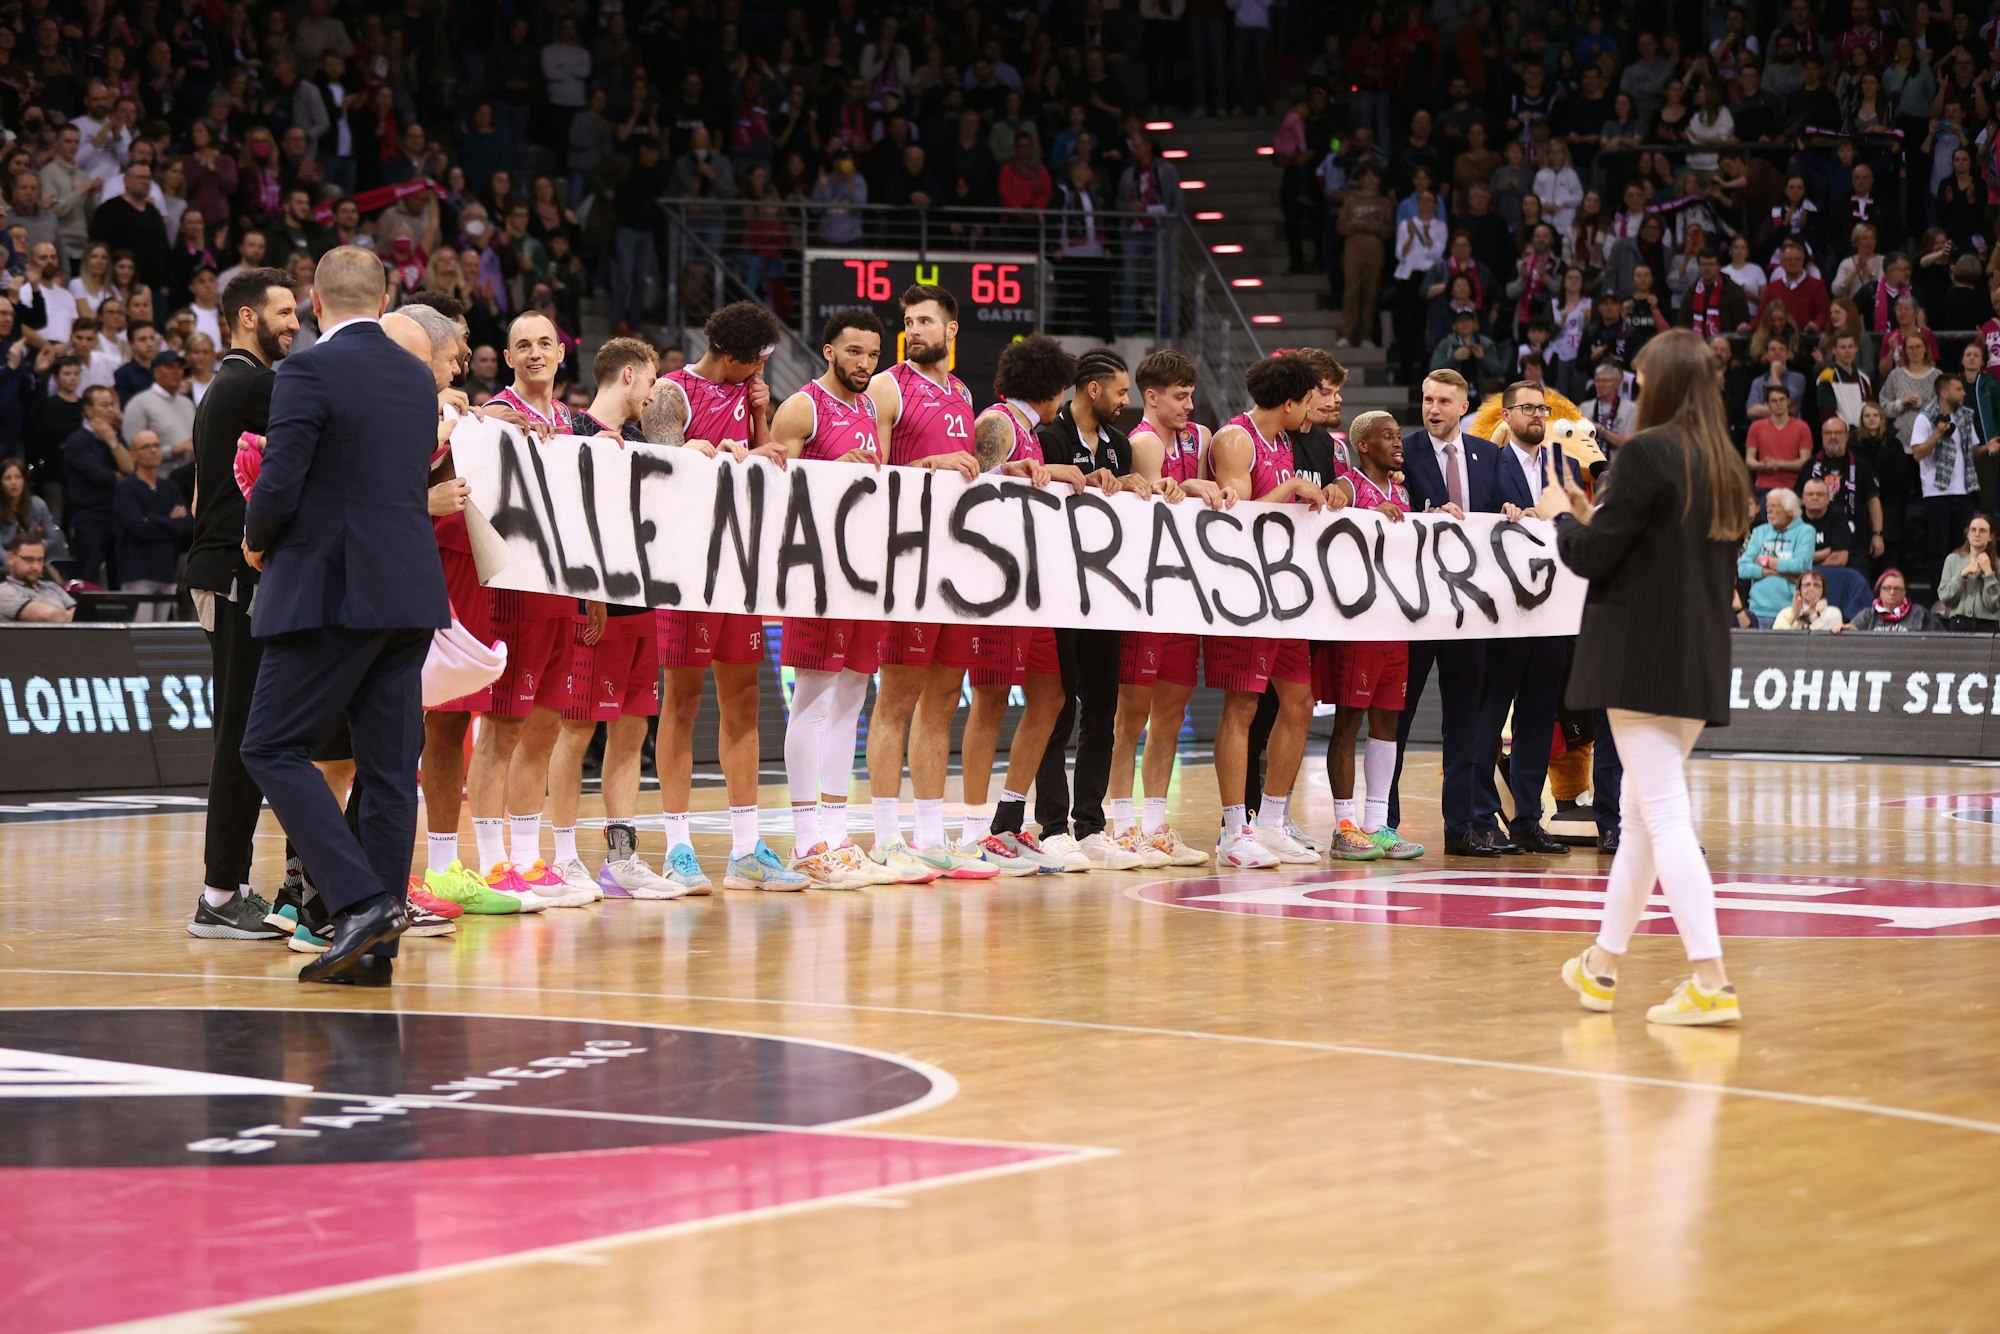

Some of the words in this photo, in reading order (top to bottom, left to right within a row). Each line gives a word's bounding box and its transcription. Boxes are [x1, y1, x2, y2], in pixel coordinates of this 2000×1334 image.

[843, 259, 892, 301] 76
[971, 263, 1021, 305] 66
[733, 395, 746, 422] 6
[944, 413, 968, 438] 21
[855, 432, 877, 453] 24
[490, 432, 682, 607] ALLE
[0, 675, 152, 734] LOHNT
[1729, 667, 1892, 712] LOHNT
